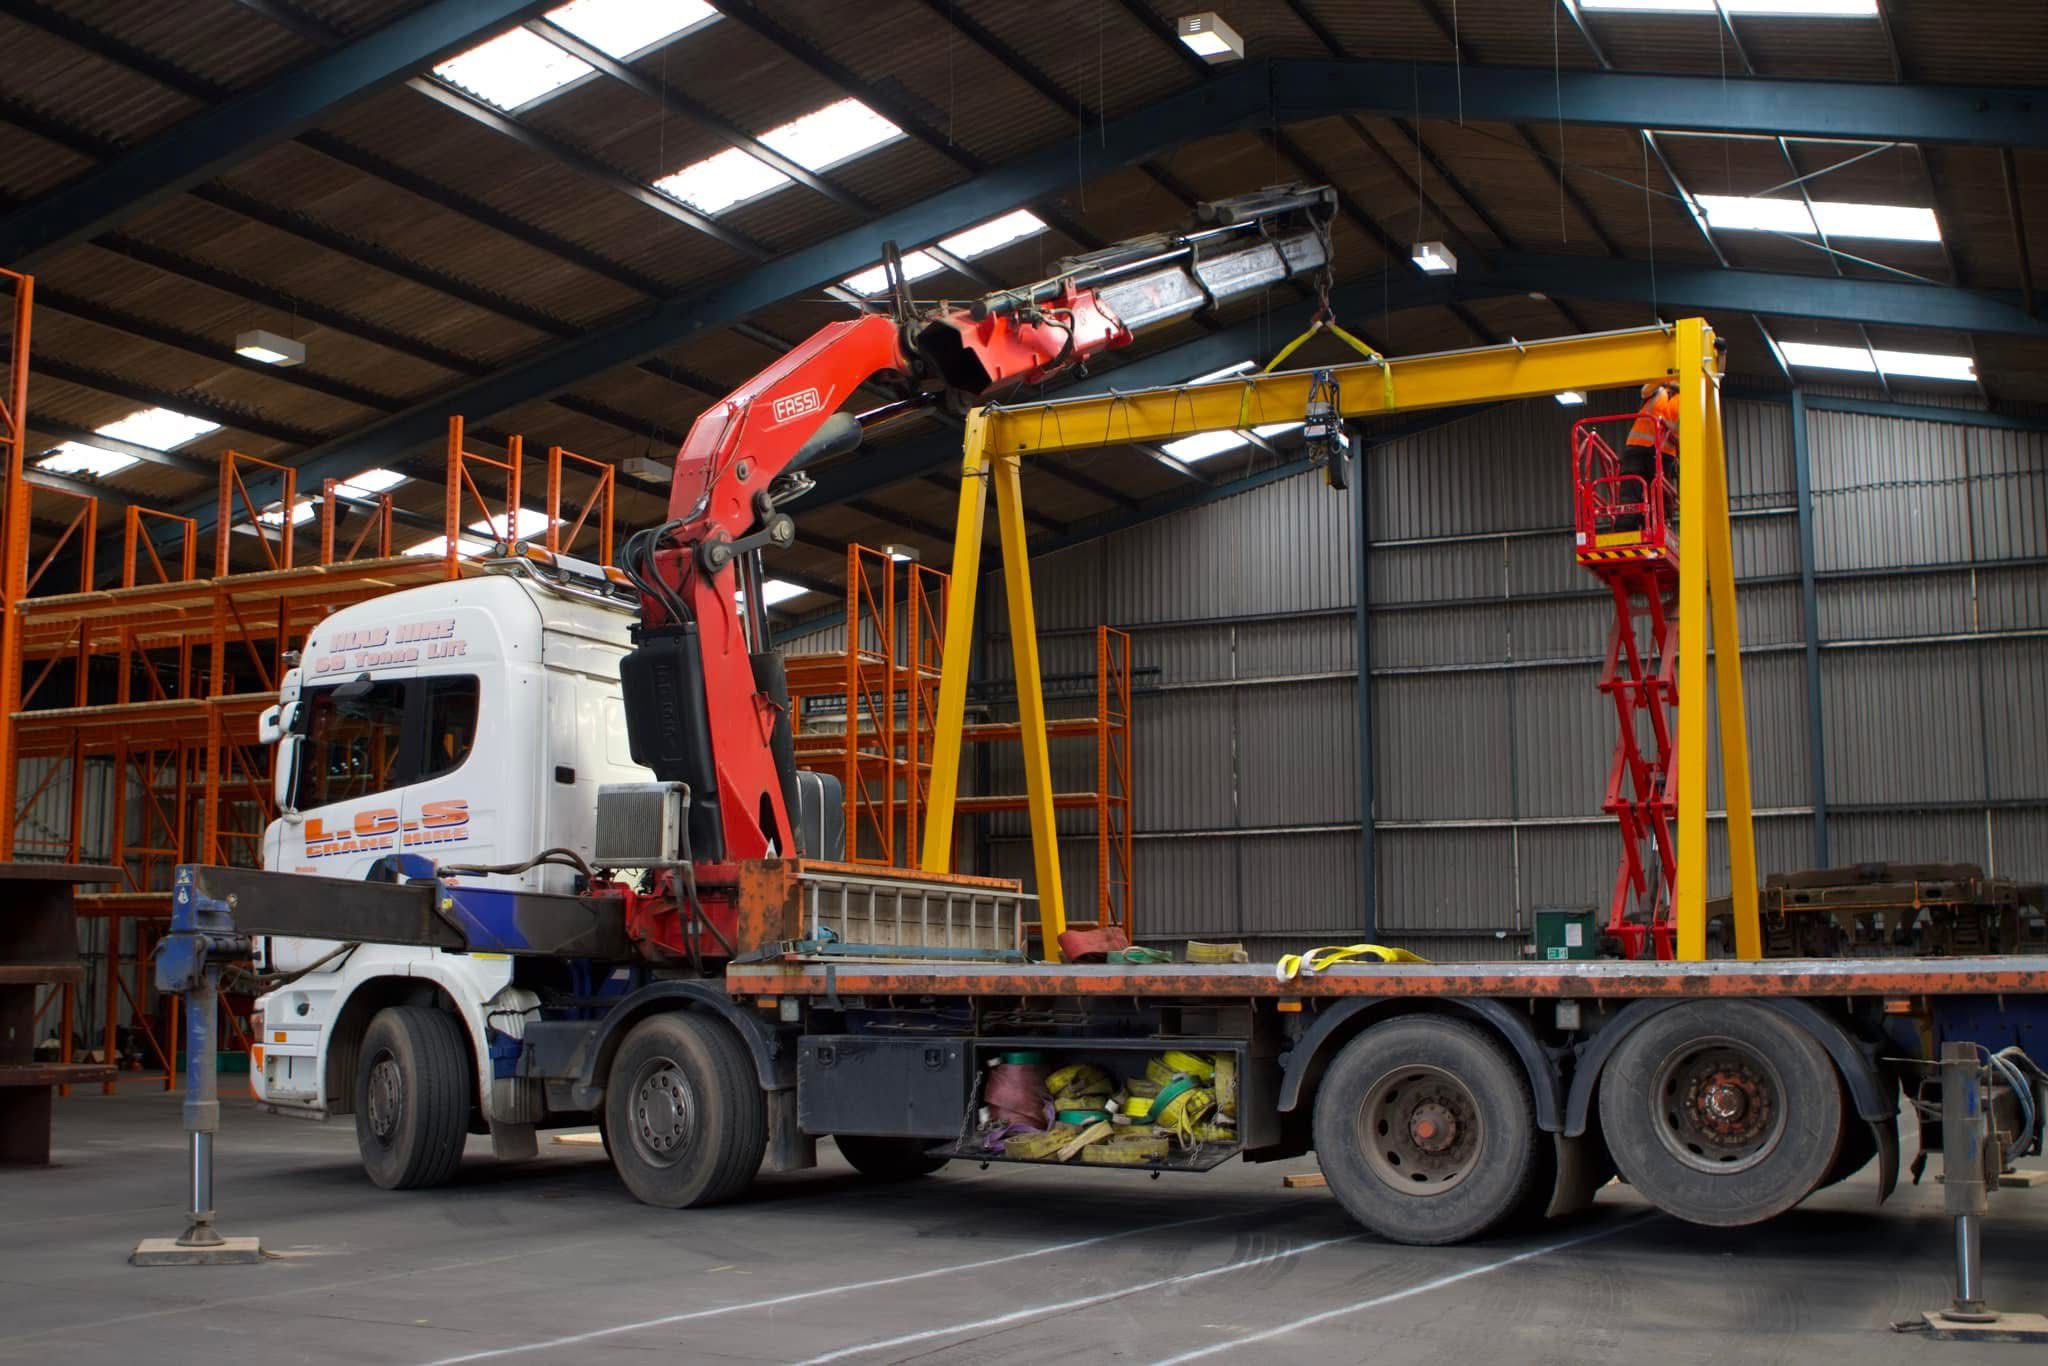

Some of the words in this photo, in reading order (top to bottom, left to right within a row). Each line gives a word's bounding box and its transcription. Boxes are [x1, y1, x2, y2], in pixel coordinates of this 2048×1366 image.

[776, 391, 817, 419] FASSI
[396, 619, 456, 644] HIRE
[304, 800, 470, 844] L.C.S
[306, 837, 394, 858] CRANE
[402, 829, 469, 847] HIRE
